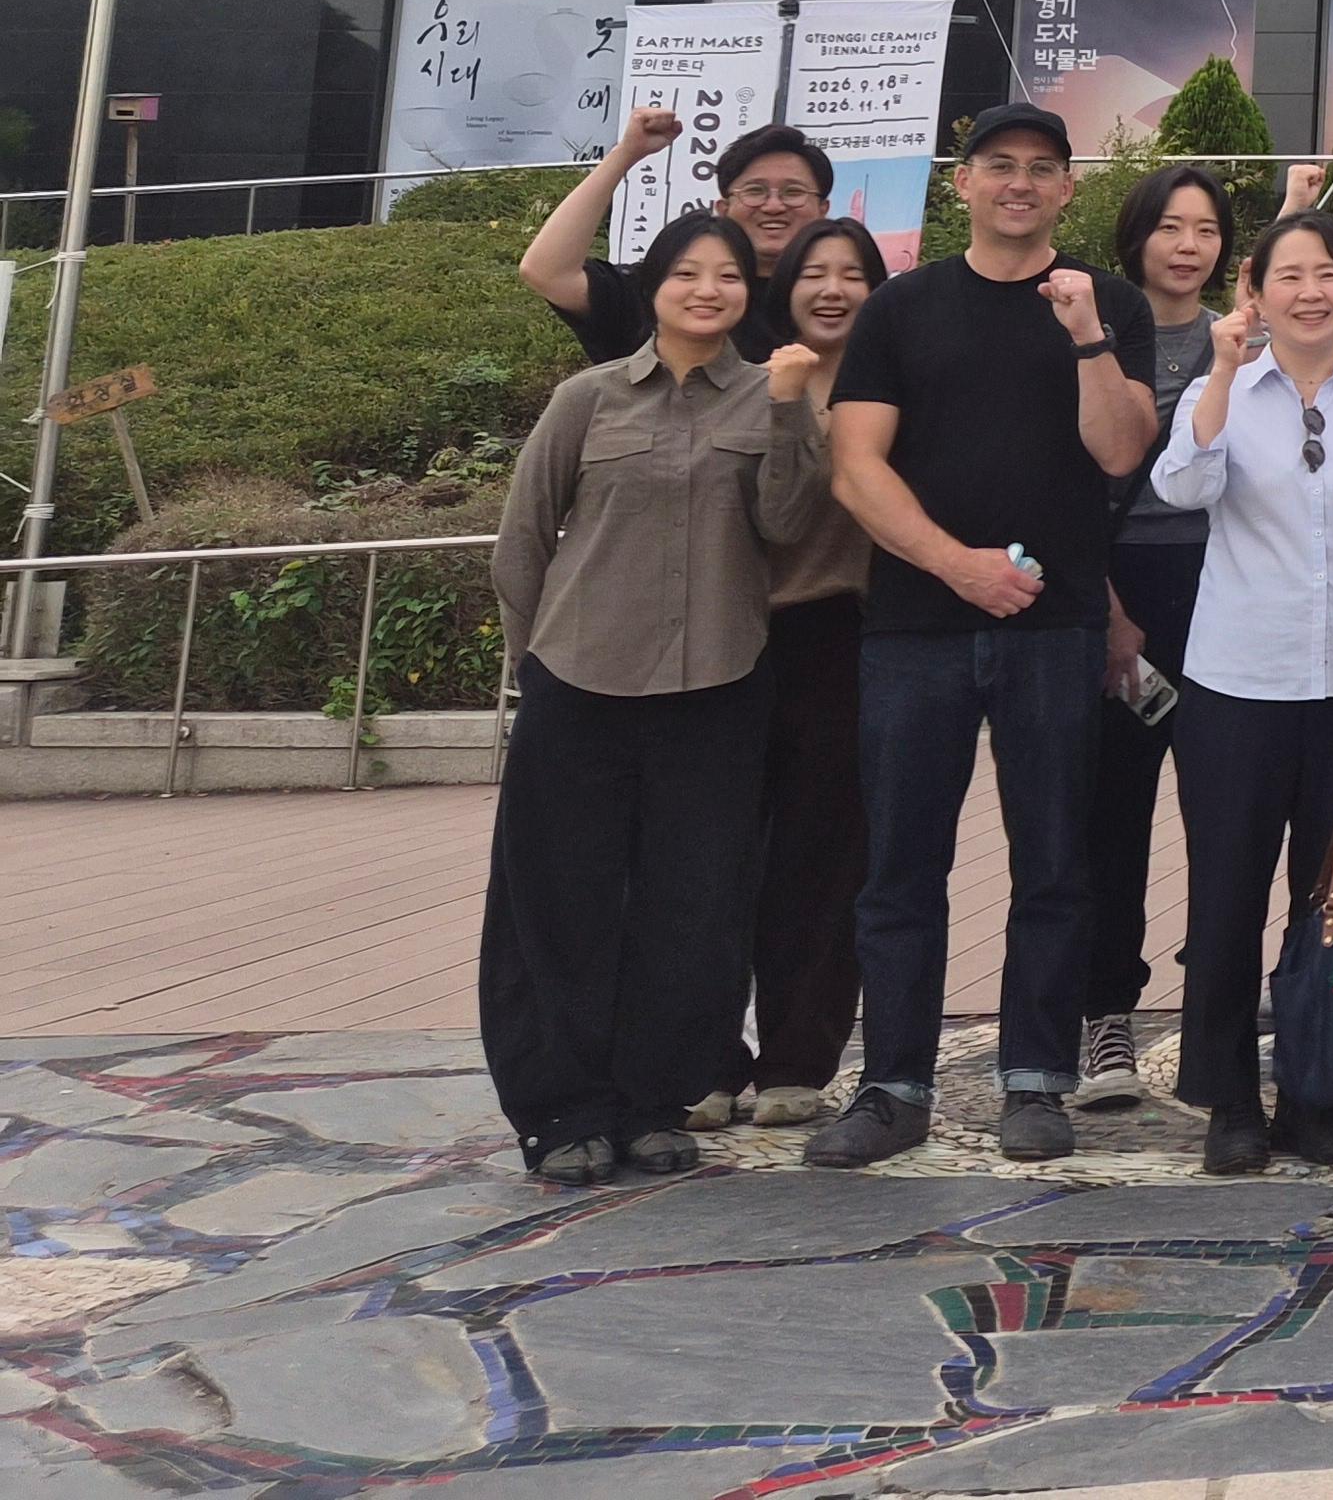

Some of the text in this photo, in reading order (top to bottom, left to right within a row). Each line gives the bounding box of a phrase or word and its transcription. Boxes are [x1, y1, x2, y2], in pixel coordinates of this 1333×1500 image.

[636, 35, 763, 49] EARTH MAKES
[870, 31, 937, 42] CERAMICS
[1033, 23, 1078, 44] 도자
[820, 43, 921, 56] BIENNALE 2026
[1034, 49, 1100, 71] 박물관
[420, 51, 481, 100] 시대
